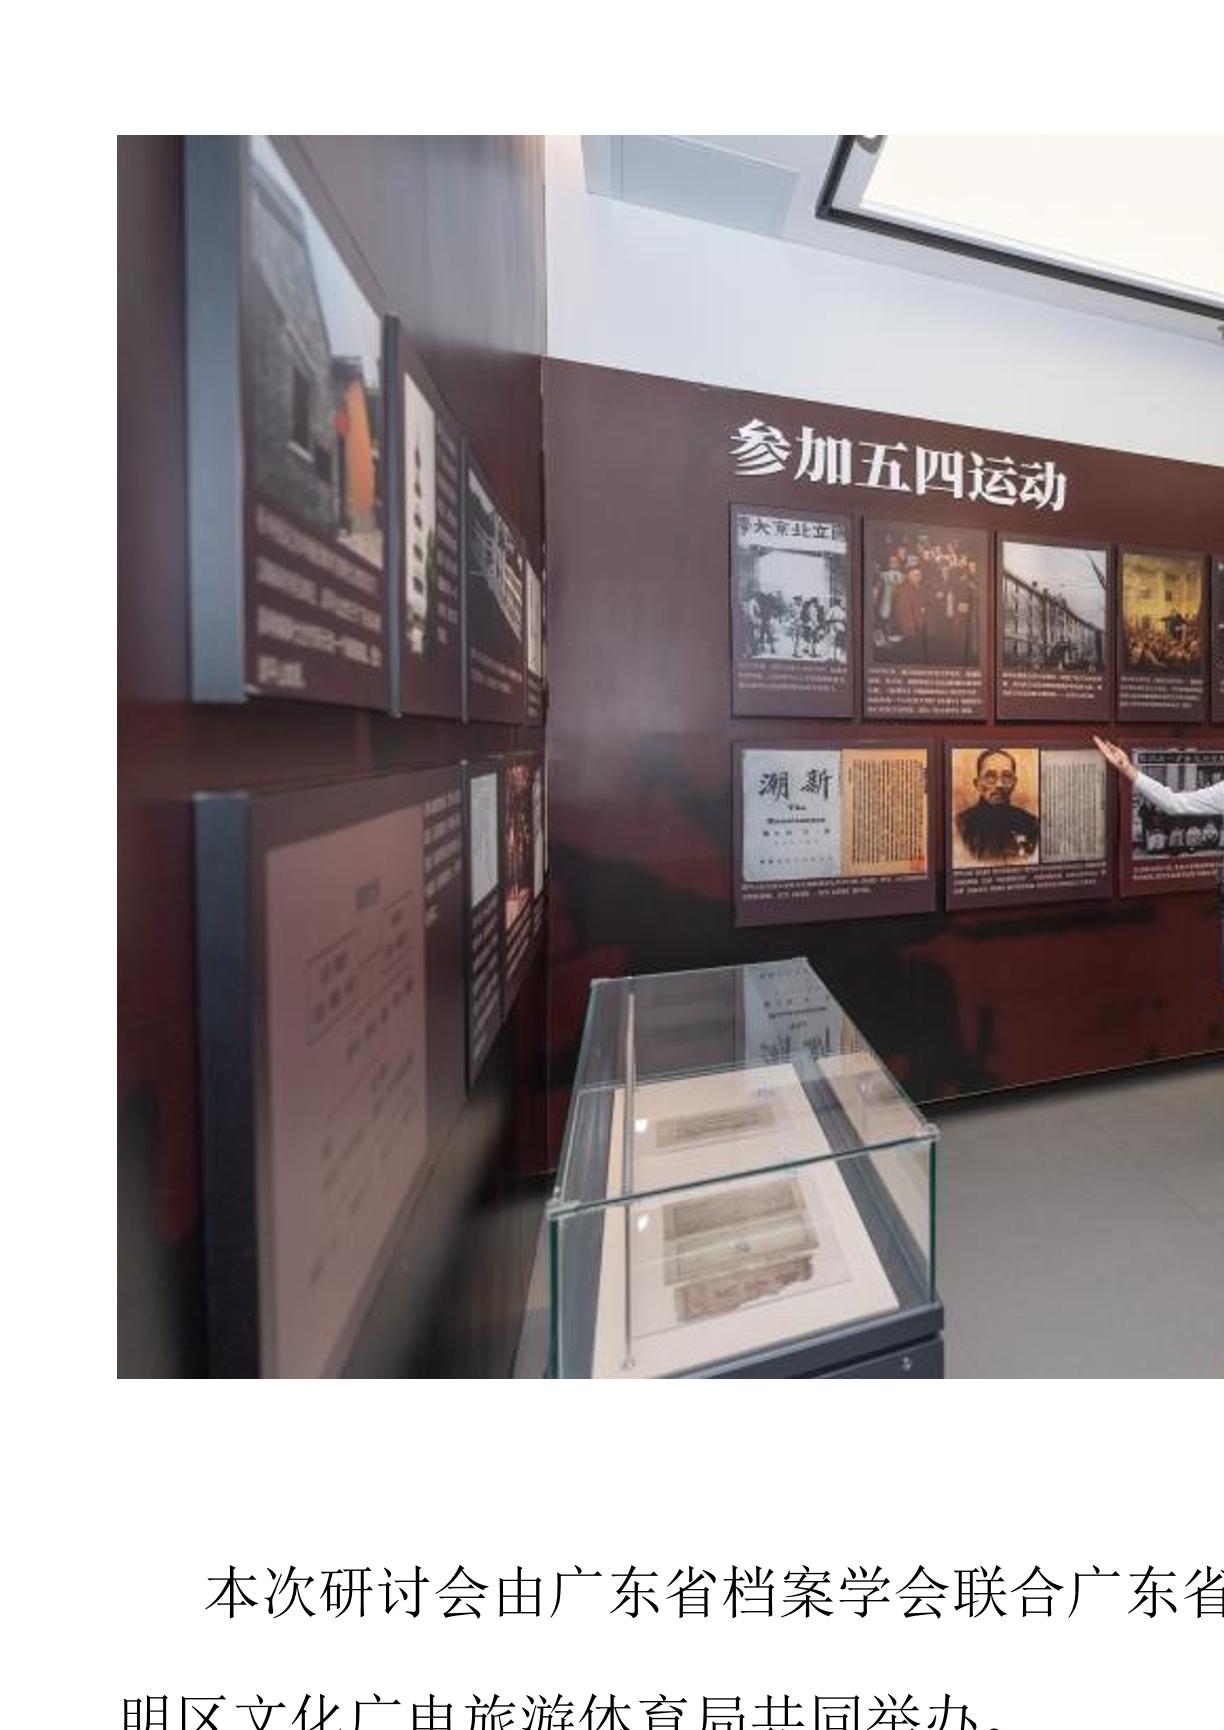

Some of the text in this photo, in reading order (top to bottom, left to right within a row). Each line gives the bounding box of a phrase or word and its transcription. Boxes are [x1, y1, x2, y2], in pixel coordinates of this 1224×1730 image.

[730, 418, 1067, 512] 参加五四运动
